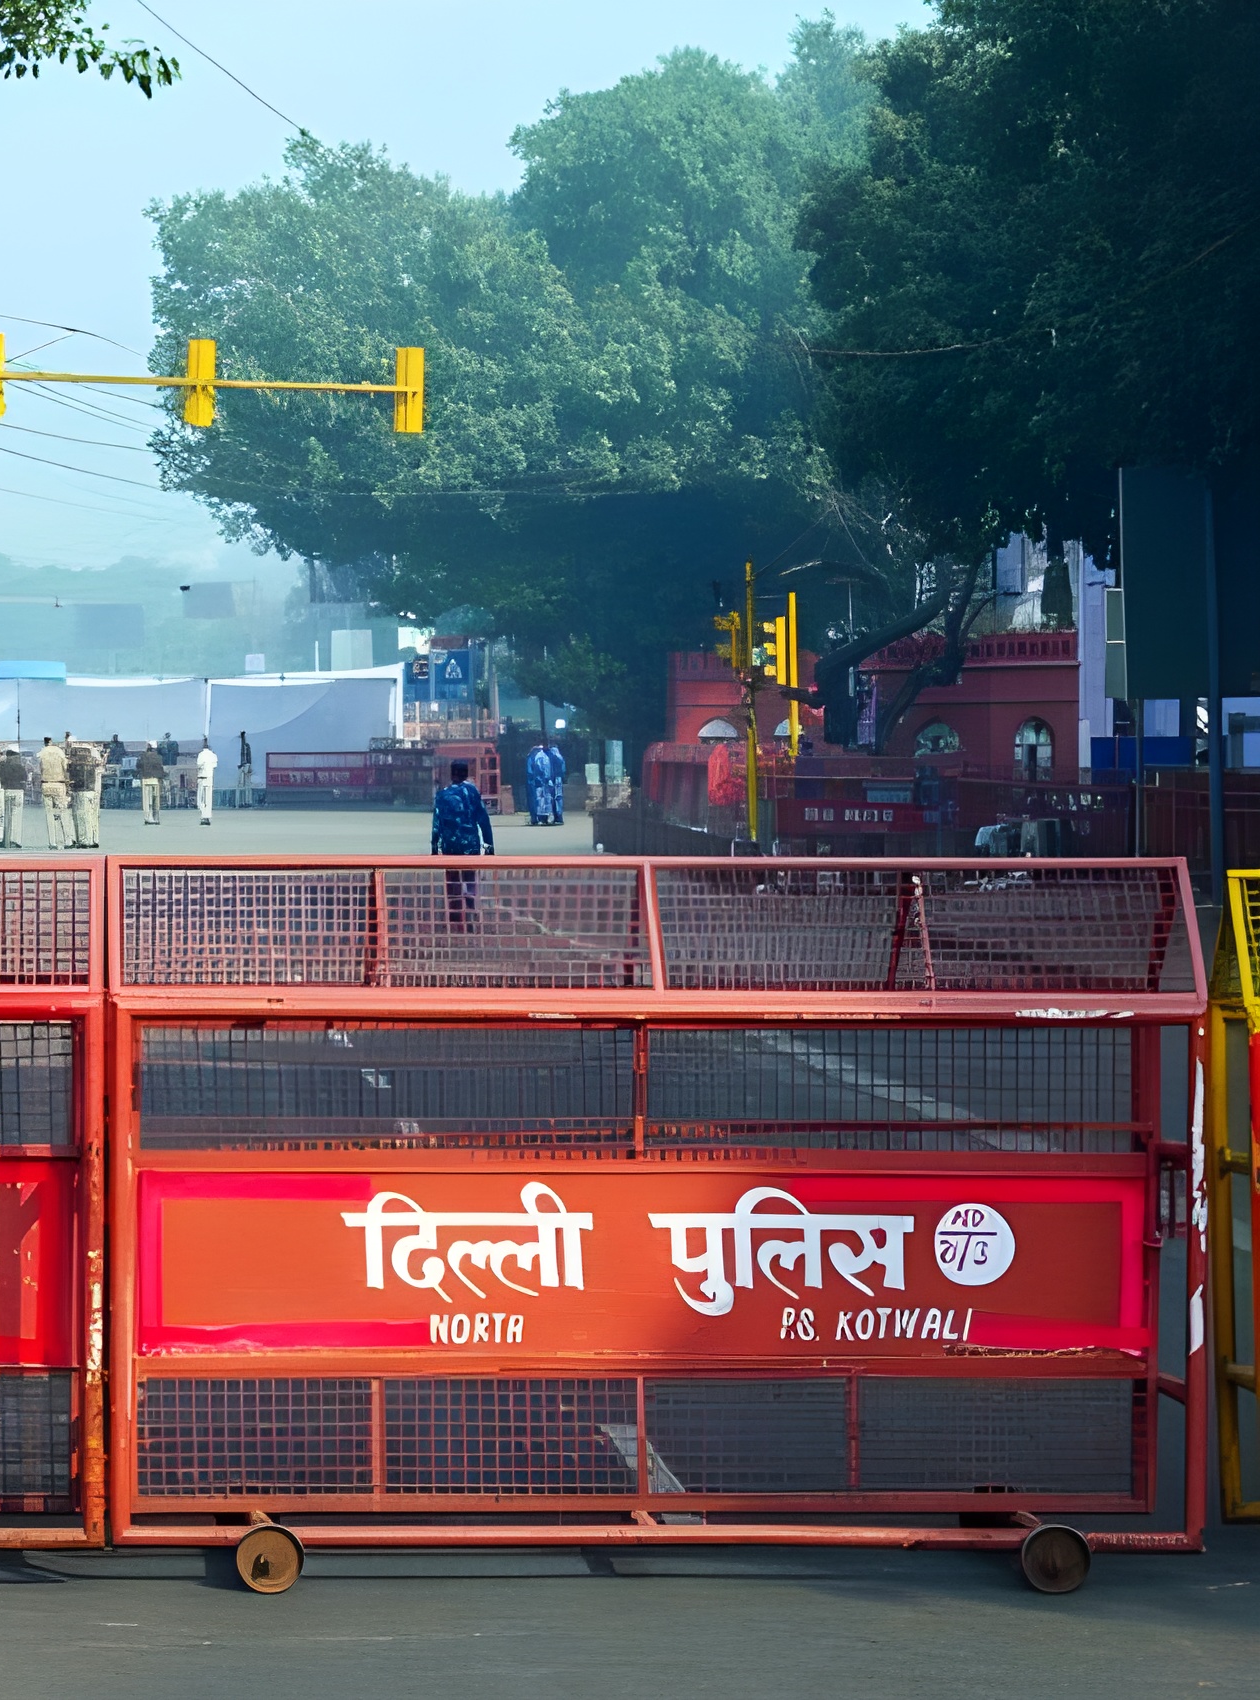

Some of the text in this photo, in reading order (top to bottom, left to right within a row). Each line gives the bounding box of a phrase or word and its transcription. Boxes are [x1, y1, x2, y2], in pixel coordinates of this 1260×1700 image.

[340, 1181, 914, 1316] दिल्ली पुलिस
[835, 1307, 973, 1342] KOTWALI
